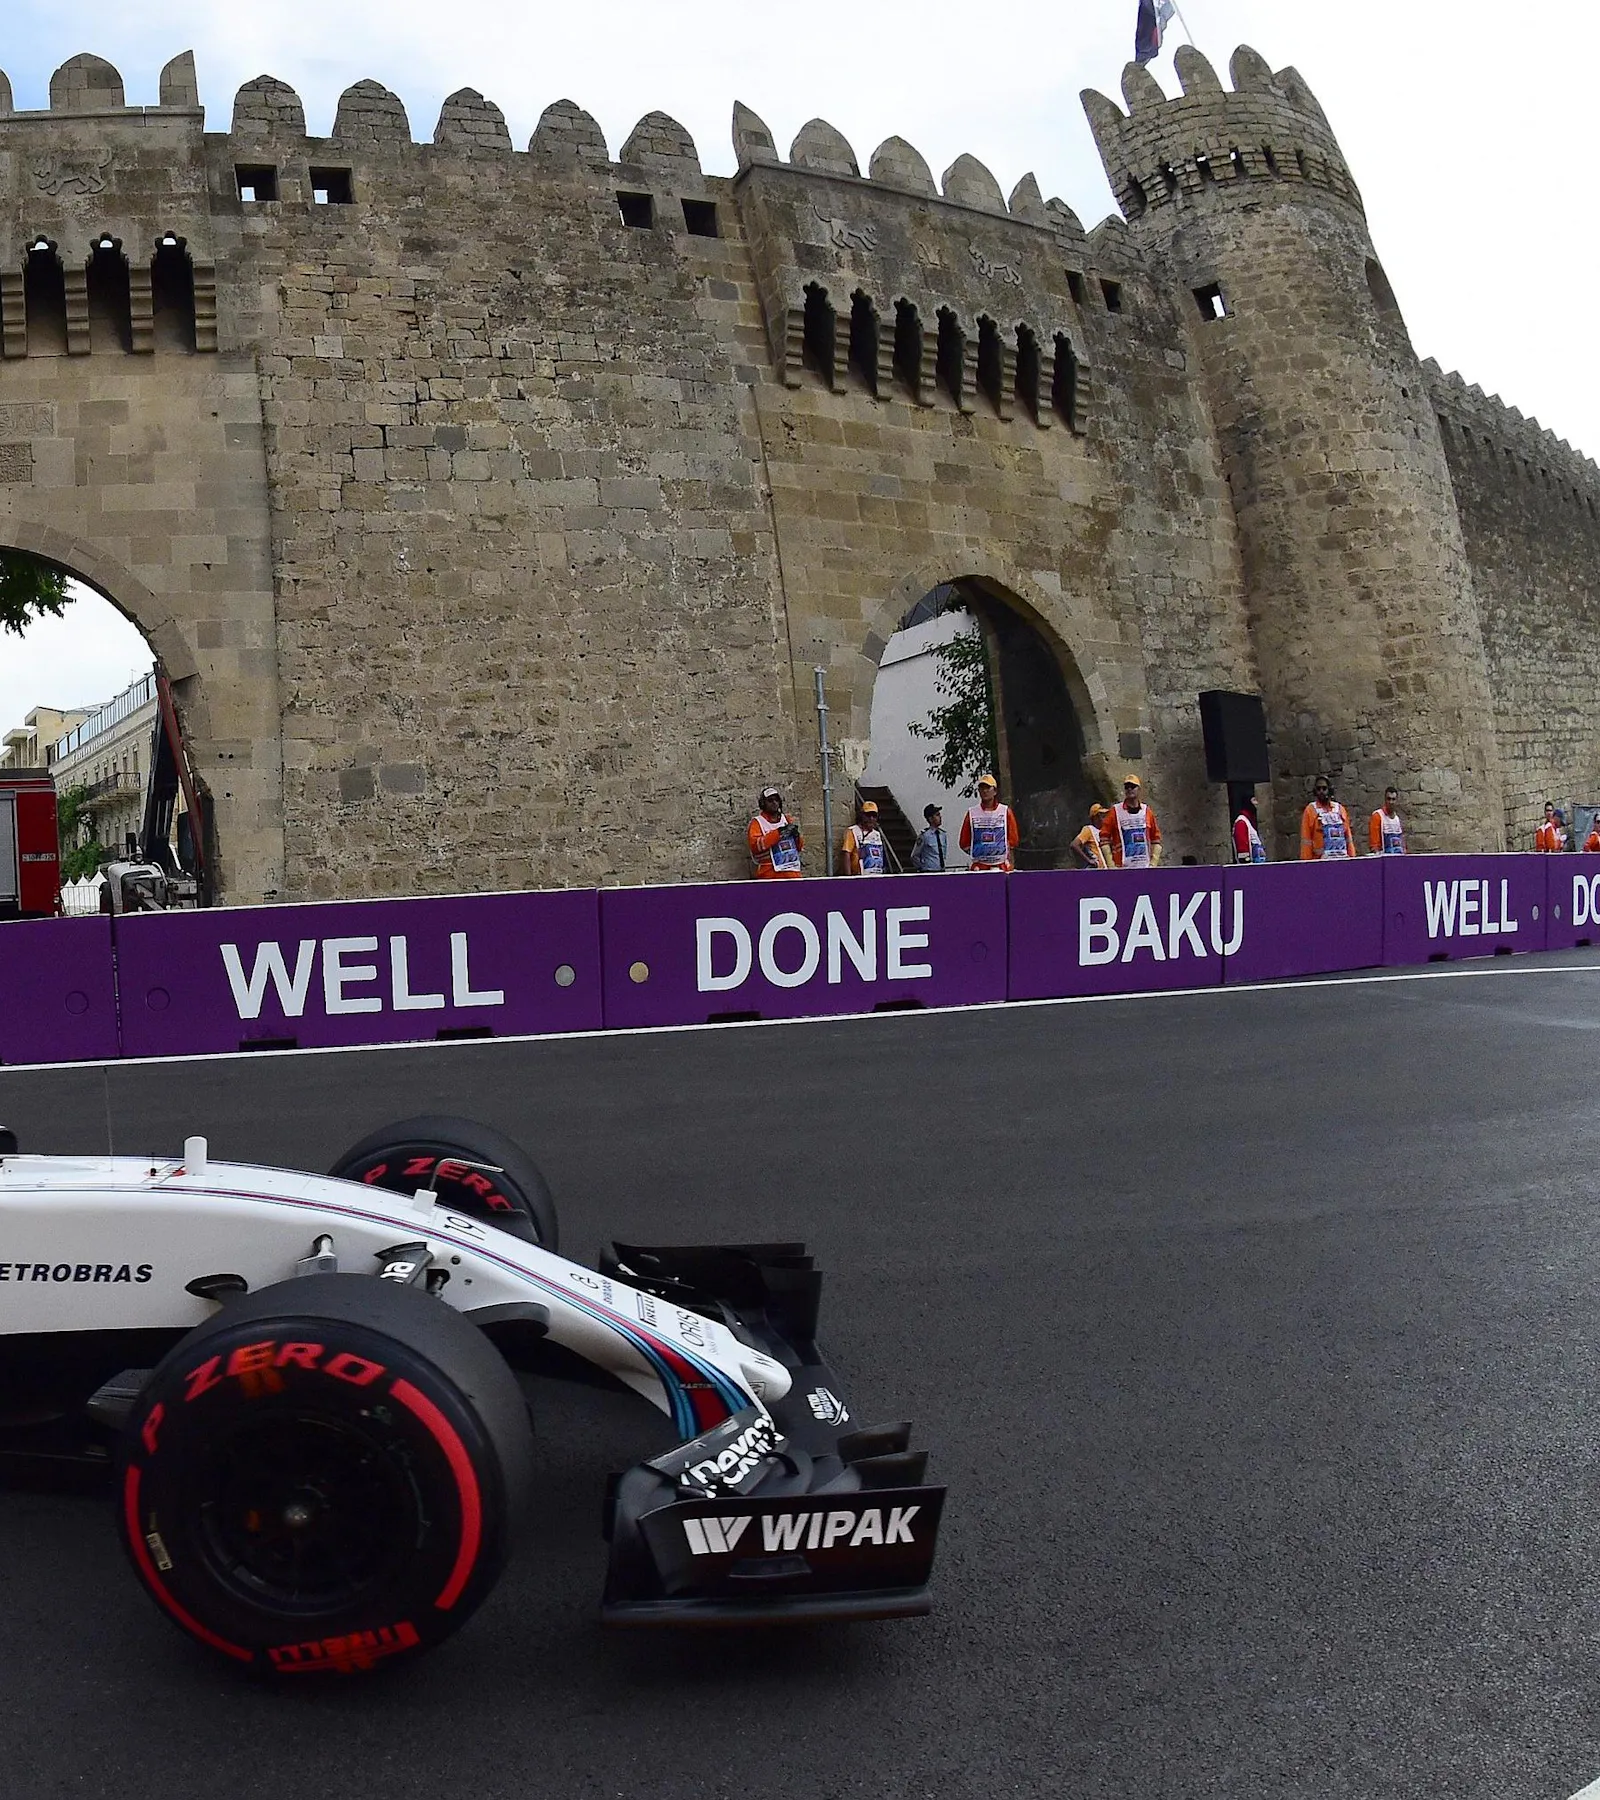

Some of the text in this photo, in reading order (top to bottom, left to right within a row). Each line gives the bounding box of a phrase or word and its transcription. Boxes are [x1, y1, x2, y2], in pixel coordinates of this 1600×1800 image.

[1423, 878, 1518, 939] WELL
[220, 889, 1244, 1018] WELL DONE BAKU
[362, 1163, 388, 1185] P
[443, 1215, 487, 1241] 19
[635, 1292, 658, 1328] PIRELLI
[676, 1310, 705, 1347] ORIS
[141, 1340, 388, 1455] P ZERO
[761, 1506, 921, 1552] WIPAK
